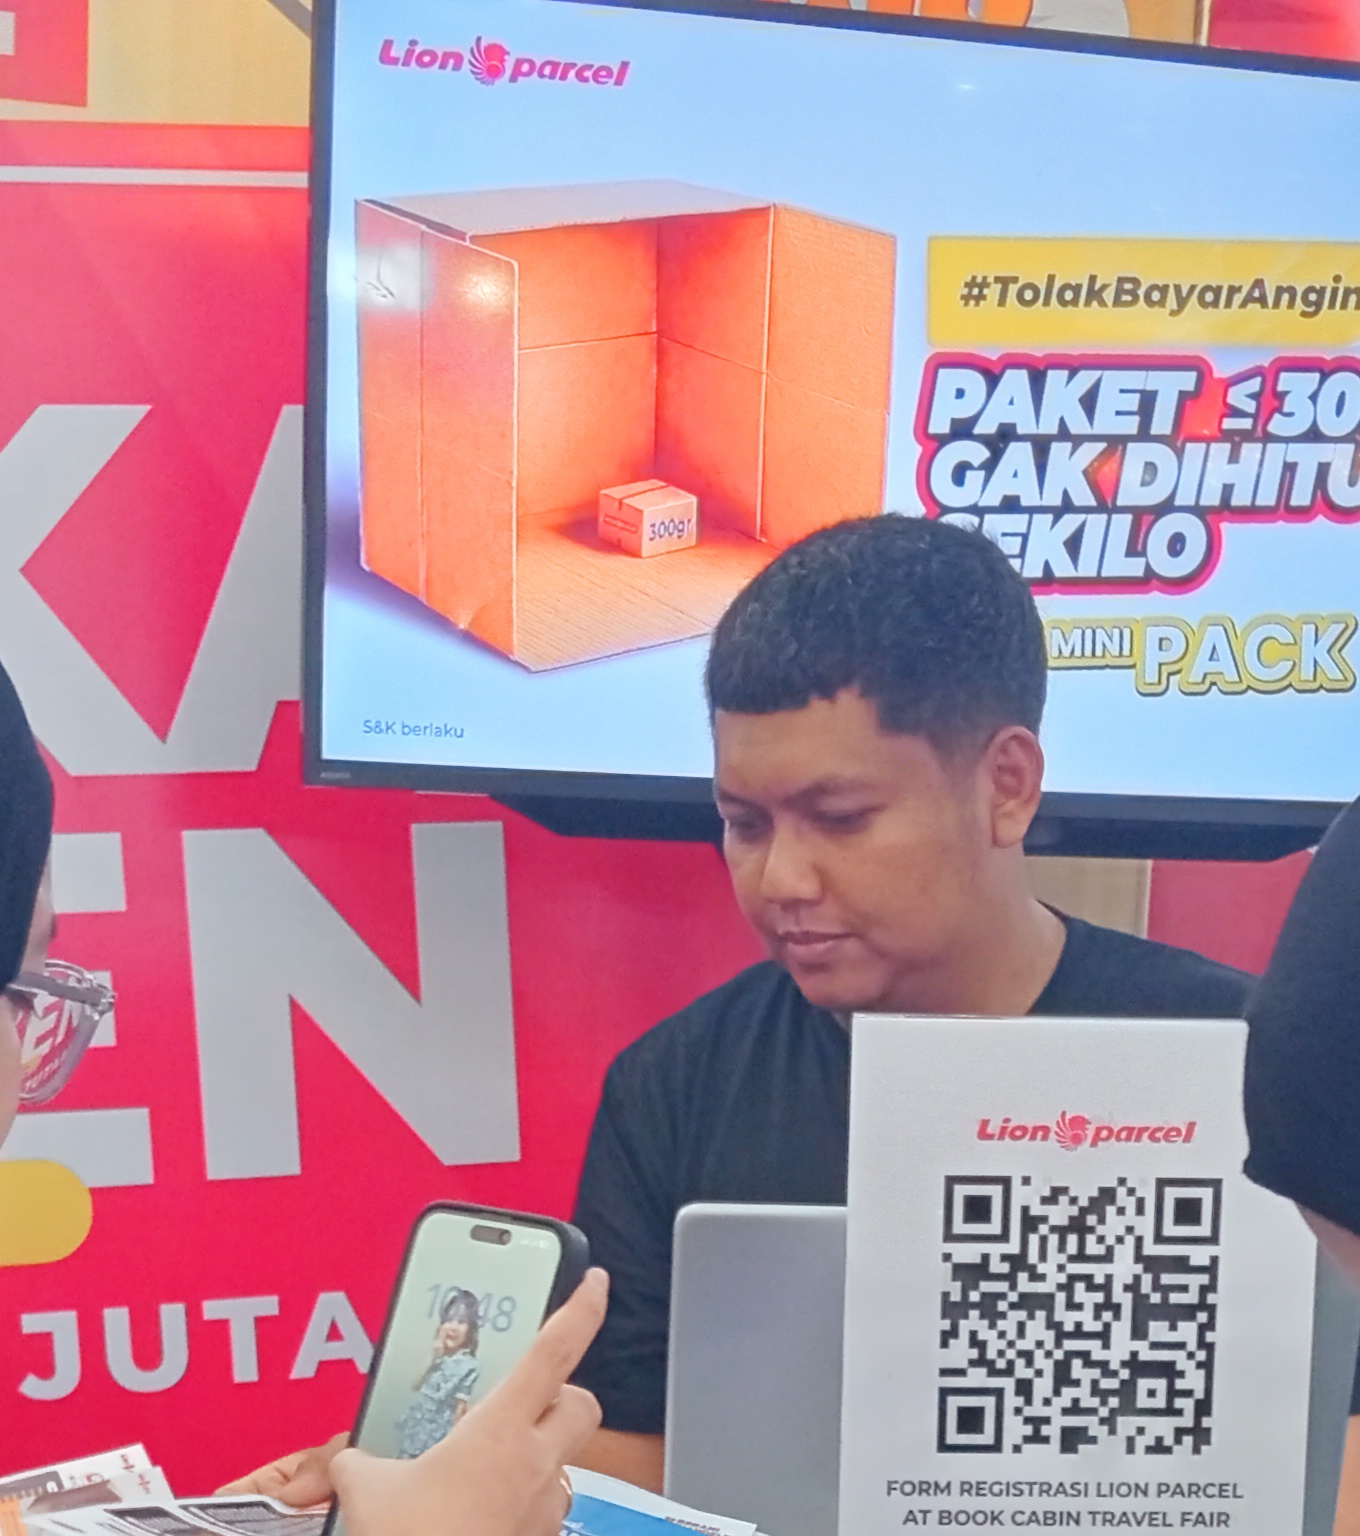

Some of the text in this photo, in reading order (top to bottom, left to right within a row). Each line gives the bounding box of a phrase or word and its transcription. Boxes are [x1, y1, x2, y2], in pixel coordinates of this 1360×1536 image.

[378, 38, 631, 87] Lion parcel
[926, 366, 1205, 436] PAKET
[928, 438, 1104, 509] GAK
[1048, 621, 1349, 686] MINI PACK
[362, 719, 465, 739] S&K berlaku
[976, 1117, 1198, 1149] Lion parcel
[885, 1479, 1245, 1500] FORM REGISTRASI LION PARCEL
[901, 1509, 1232, 1529] AT BOOK CABIN TRAVEL FAIR
